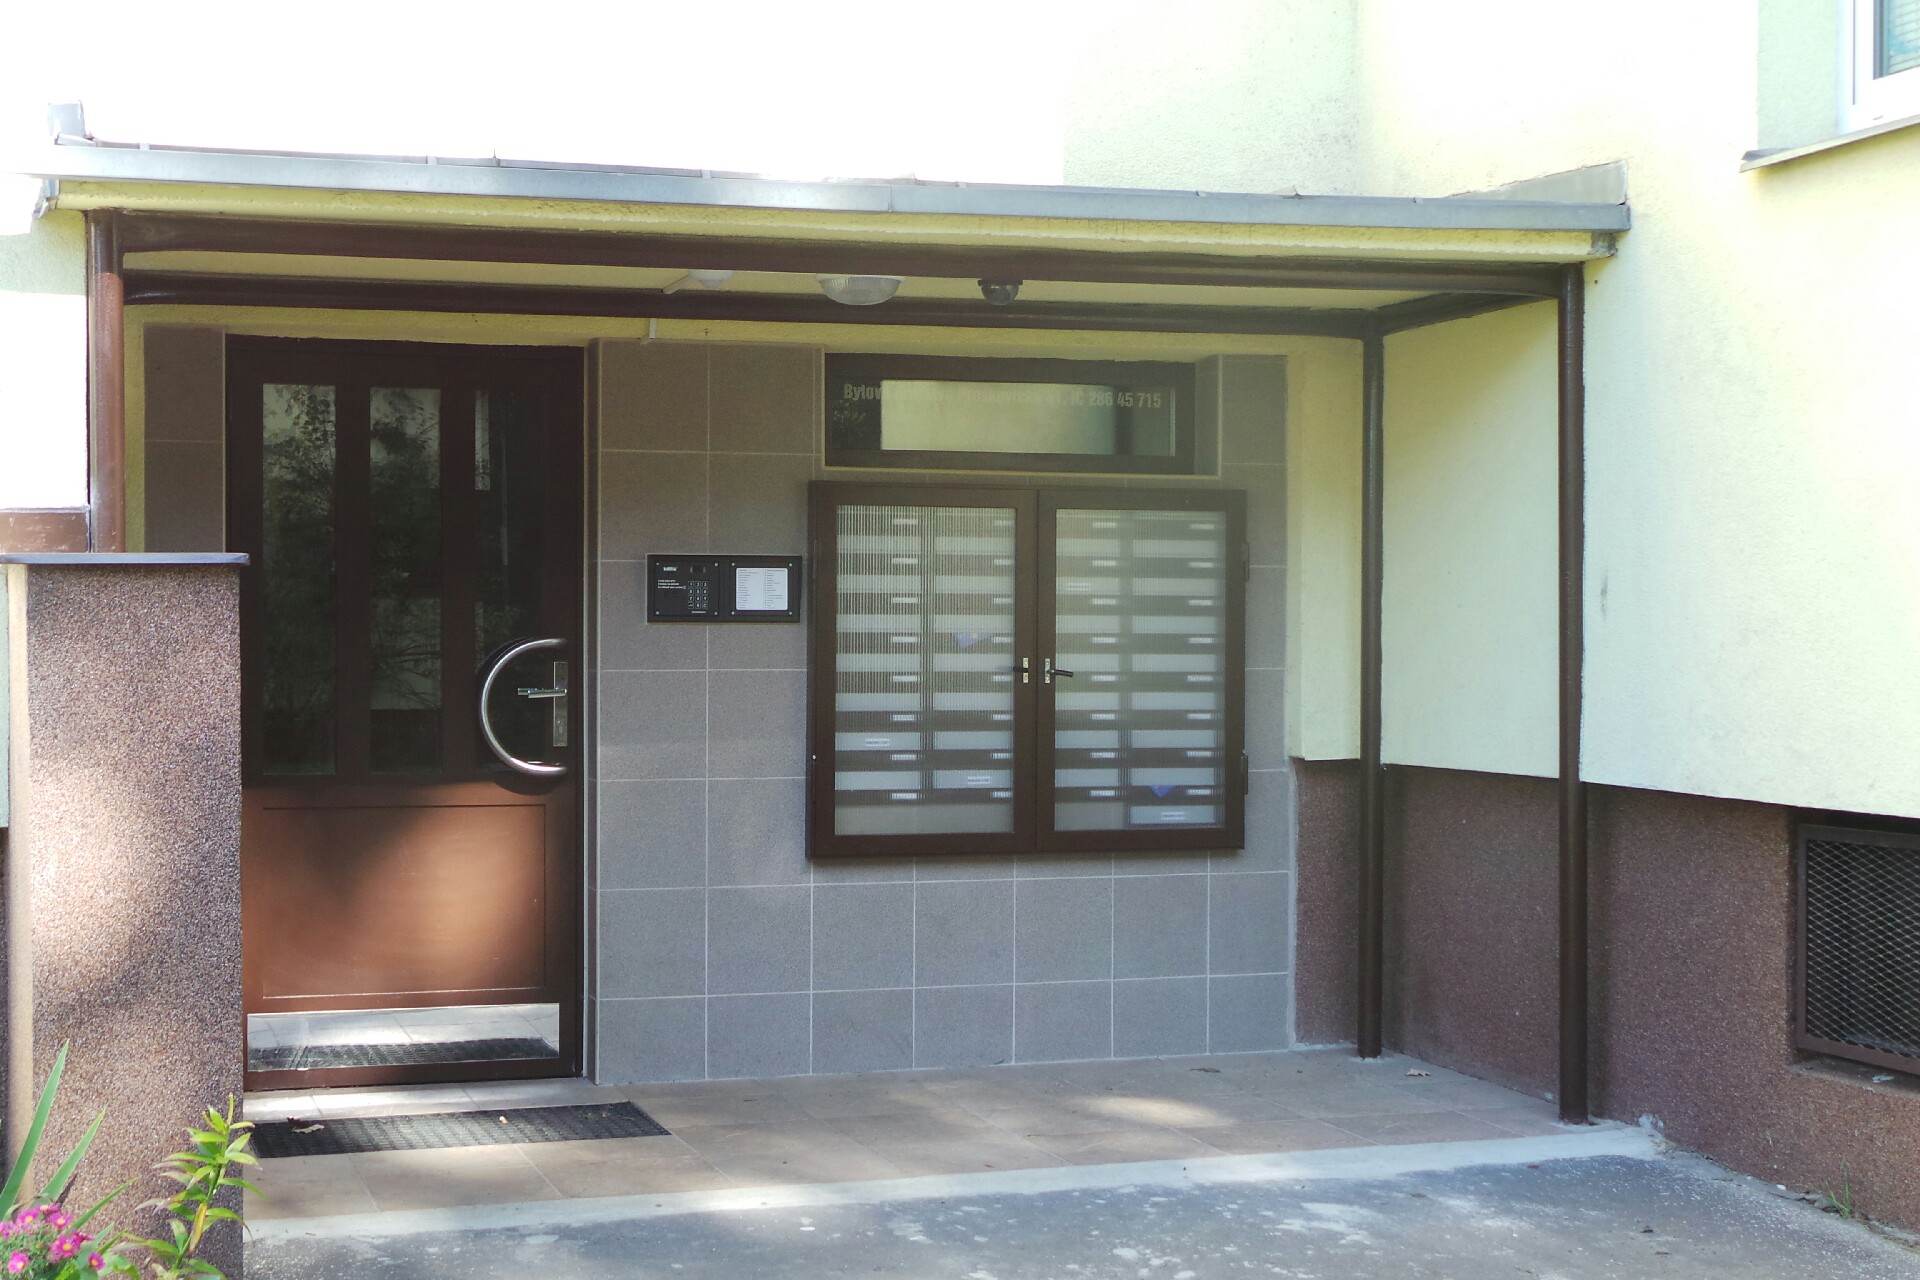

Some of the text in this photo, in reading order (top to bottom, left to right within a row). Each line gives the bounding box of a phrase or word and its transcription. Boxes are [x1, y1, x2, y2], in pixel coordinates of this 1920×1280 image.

[1087, 392, 1113, 406] 286
[1117, 392, 1134, 407] 45
[1138, 393, 1161, 409] 715
